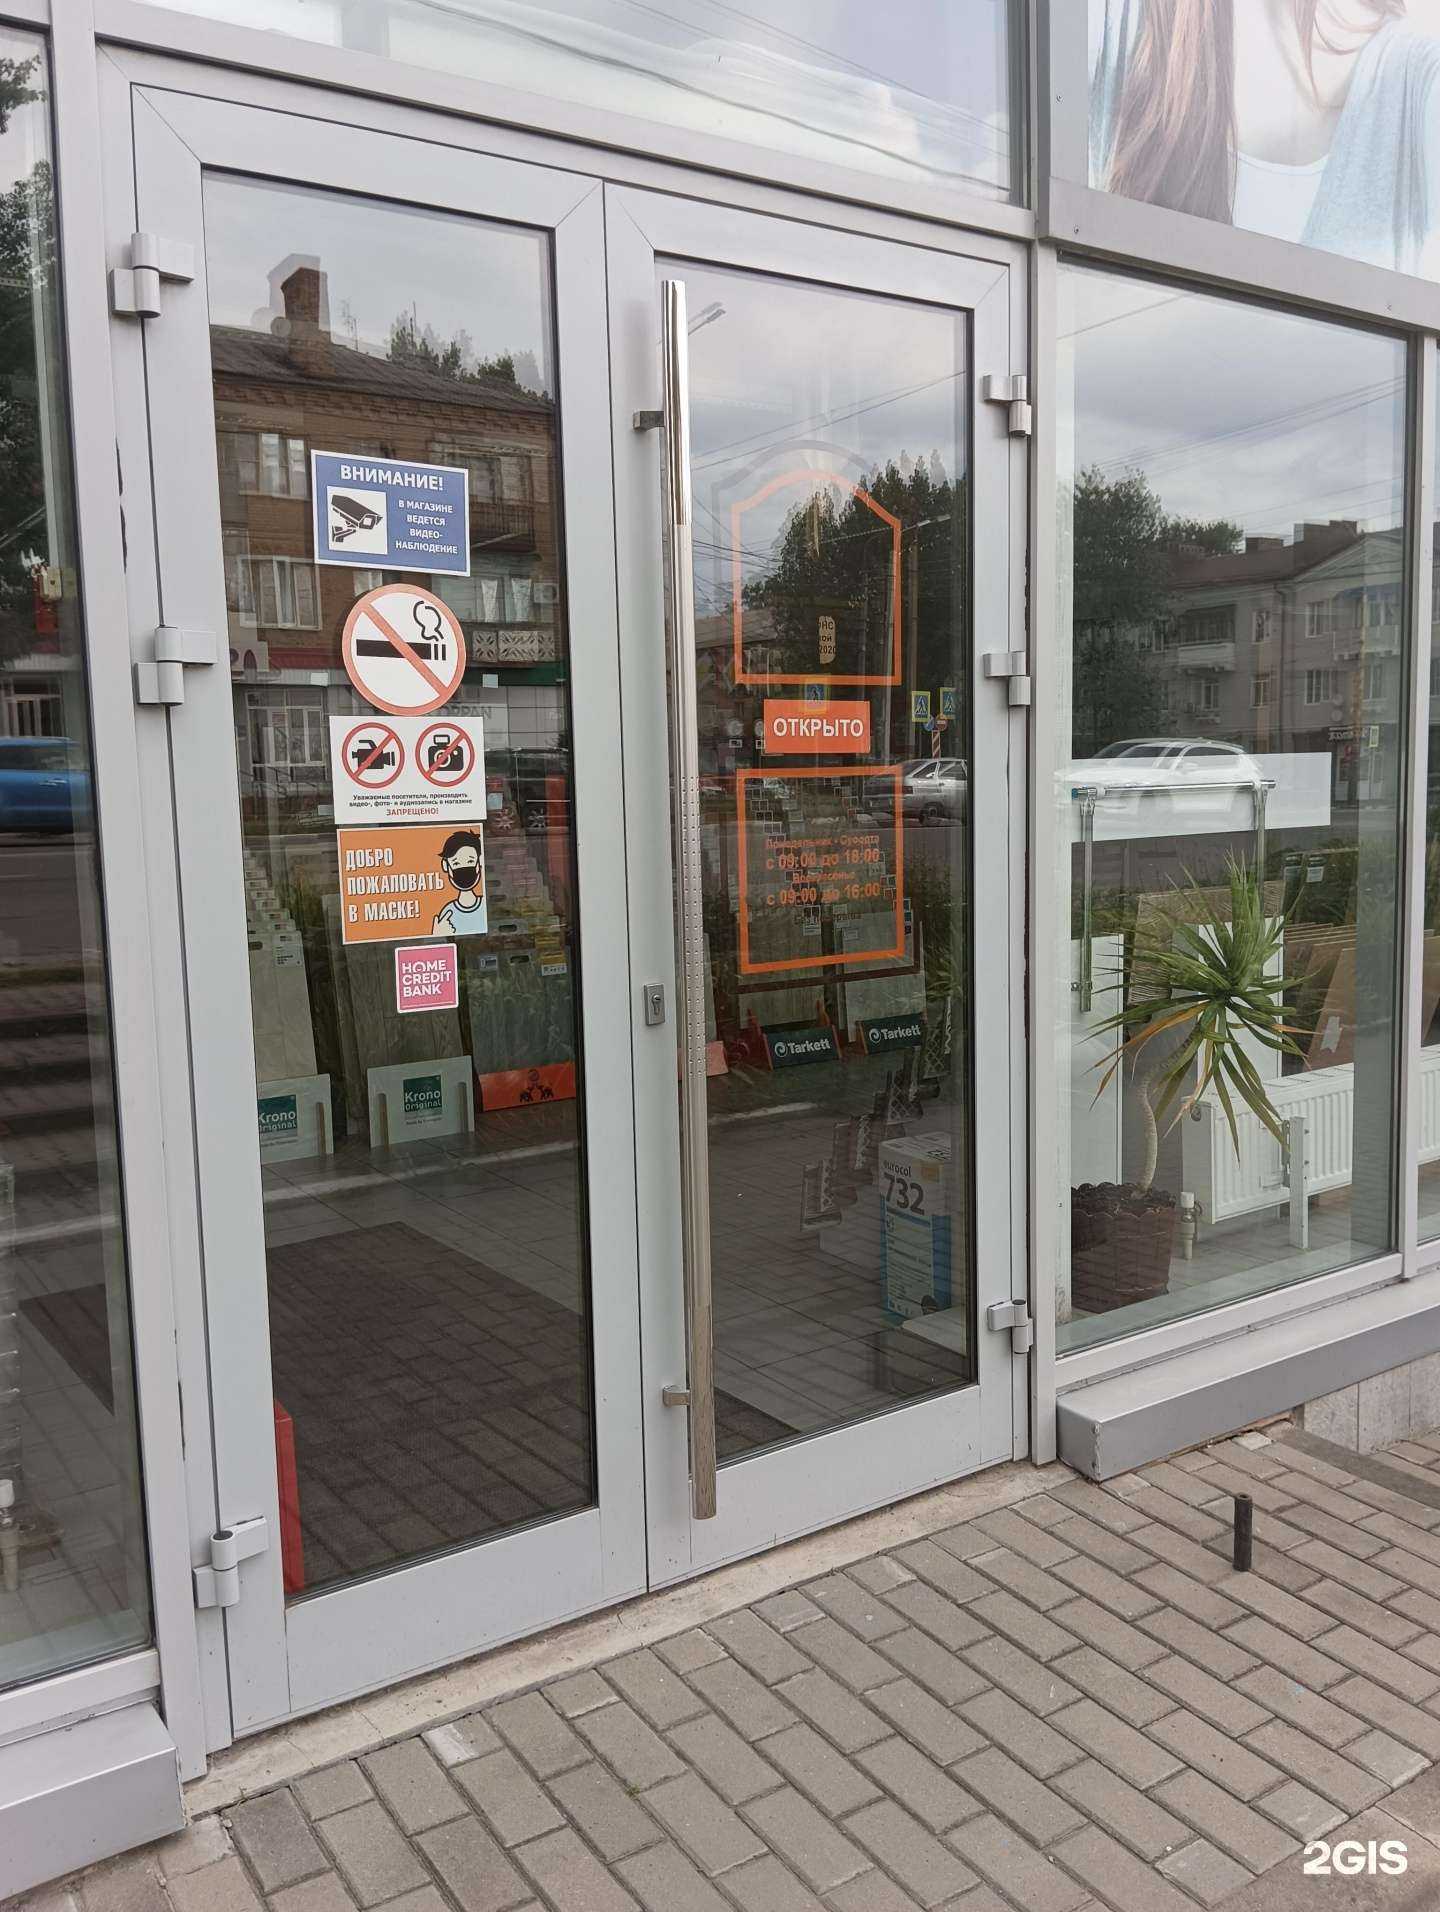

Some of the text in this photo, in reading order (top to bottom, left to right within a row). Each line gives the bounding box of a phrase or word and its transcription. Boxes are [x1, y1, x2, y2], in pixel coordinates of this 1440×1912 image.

[340, 464, 443, 491] ВНИМАНИЕ!
[399, 500, 453, 513] В МАГАЗИНЕ
[406, 514, 446, 526] ВЕДЕТСЯ
[409, 528, 443, 539] ВИДЕО-
[395, 540, 458, 554] НАБЛЮДЕНИЕ
[773, 717, 864, 737] ОТКРЫТО
[386, 807, 439, 817] ЗАПРЕЩЕНО!
[345, 847, 394, 871] ДОБРО
[766, 848, 881, 870] с 09:00 до 18:00
[346, 872, 445, 897] ПОЖАЛОВАТЬ
[766, 882, 881, 906] с 09:00 до 16:00
[348, 900, 421, 924] В МАСКЕ!
[401, 959, 447, 975] HOME
[401, 970, 452, 986] CREDIT
[402, 983, 442, 998] BANK
[880, 1024, 921, 1041] Tarkett
[788, 1038, 831, 1055] Tarkett
[404, 1090, 441, 1103] Krono
[405, 1099, 442, 1112] Original
[883, 1159, 912, 1178] eurocol
[883, 1172, 925, 1216] 732
